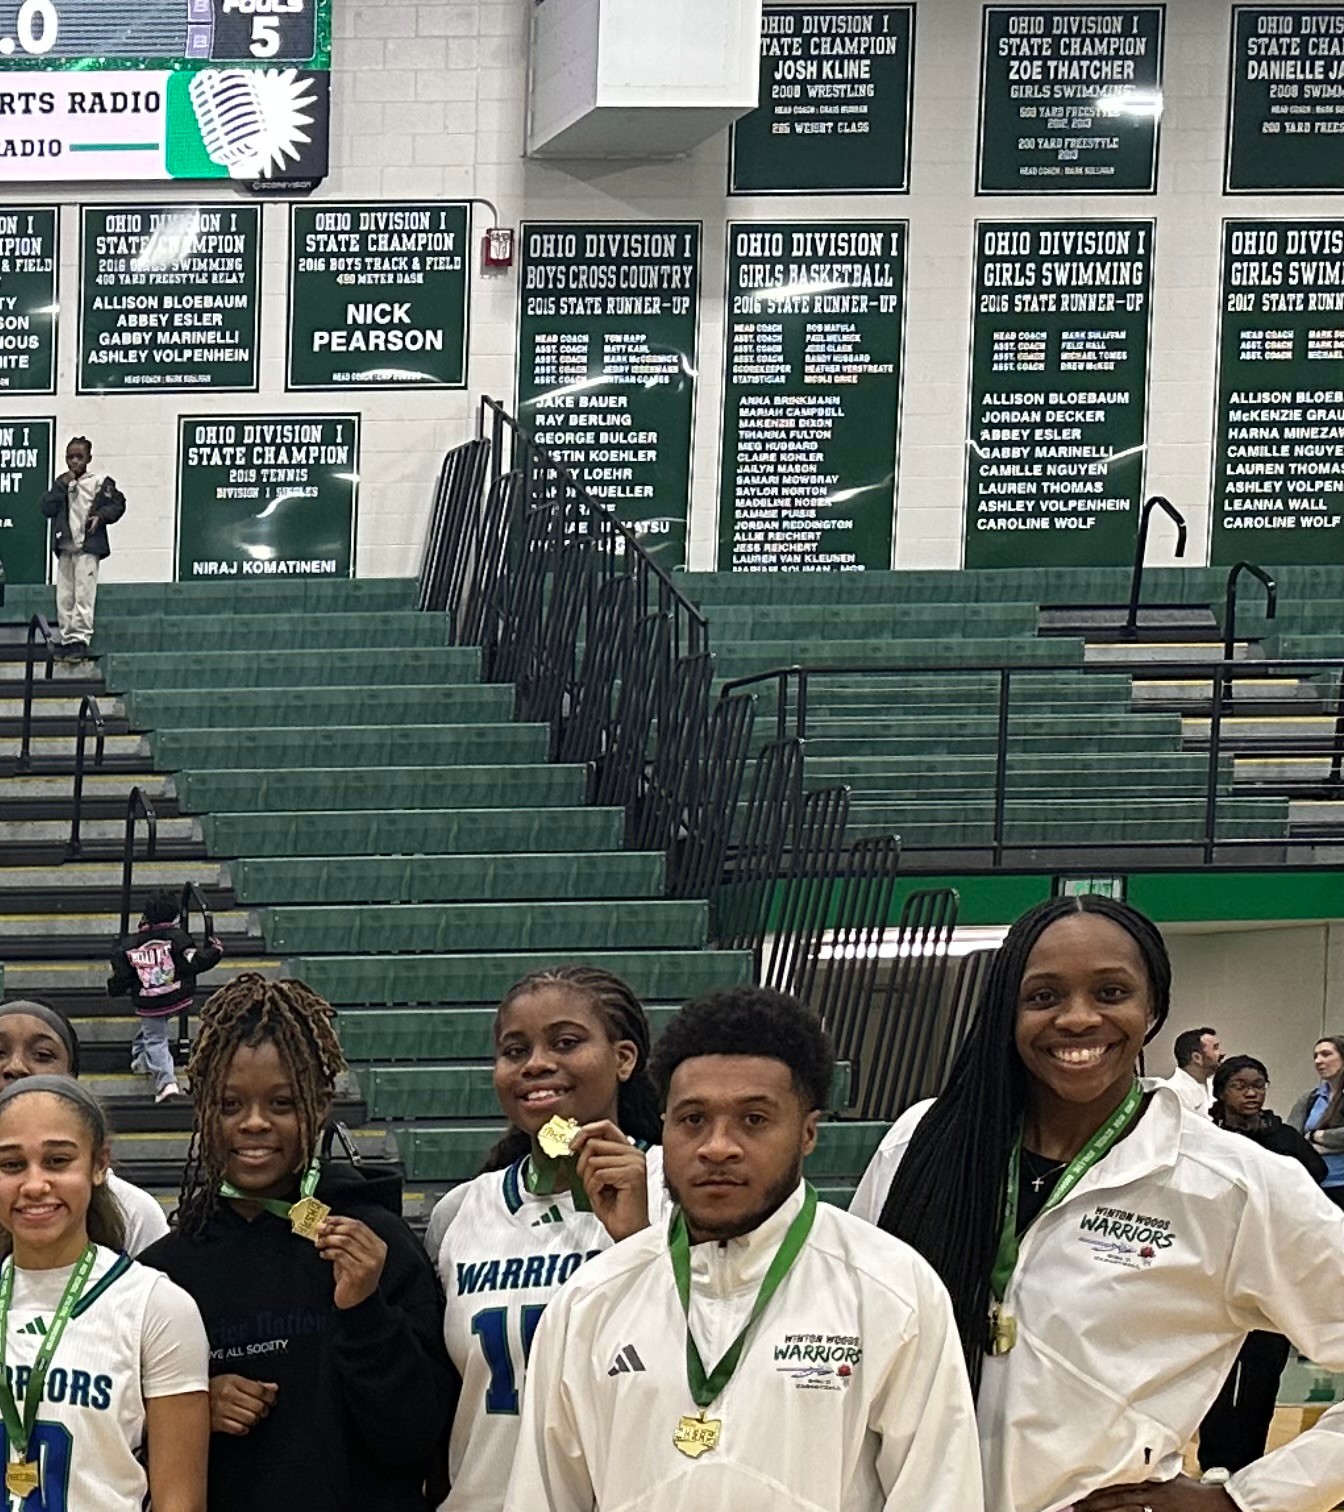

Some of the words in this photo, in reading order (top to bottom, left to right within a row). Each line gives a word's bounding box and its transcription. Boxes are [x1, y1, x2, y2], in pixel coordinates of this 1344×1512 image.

[249, 16, 281, 57] 5
[774, 60, 817, 80] JOSH
[823, 59, 870, 79] KLINE
[1009, 60, 1042, 80] ZOE
[1047, 60, 1134, 79] THATCHER
[68, 91, 160, 113] RADIO
[306, 234, 359, 252] STATE
[368, 233, 454, 251] CHAMPION
[530, 234, 576, 257] OHIO
[585, 234, 676, 257] DIVISION
[684, 234, 691, 257] I
[985, 232, 1030, 255] OHIO
[1039, 231, 1130, 254] DIVISION
[1137, 231, 1145, 254] I
[526, 266, 566, 289] BOYS
[570, 266, 616, 289] CROSS
[620, 265, 692, 288] COUNTRY
[984, 263, 1035, 286] GIRLS
[1042, 262, 1143, 286] SWIMMING
[93, 296, 158, 310] ALLISON
[163, 295, 247, 308] BLOEBAUM
[981, 295, 1008, 312] 2016
[1015, 294, 1056, 312] STATE
[1061, 293, 1143, 311] RUNNER-UP
[347, 303, 411, 324] NICK
[313, 330, 442, 352] PEARSON
[982, 411, 1041, 423] JORDAN
[1046, 411, 1104, 422] DECKER
[1224, 499, 1283, 511] LEANNA
[1289, 498, 1327, 510] WALL
[977, 518, 1049, 530] CAROLINE
[1054, 517, 1095, 528] WOLF
[193, 561, 237, 574] NIRAJ
[243, 560, 336, 574] KOMATINENI
[1095, 1206, 1135, 1221] WINTON
[1080, 1214, 1176, 1249] WARRIORS
[456, 1253, 584, 1296] WARRIO
[774, 1344, 862, 1366] WARRIORS
